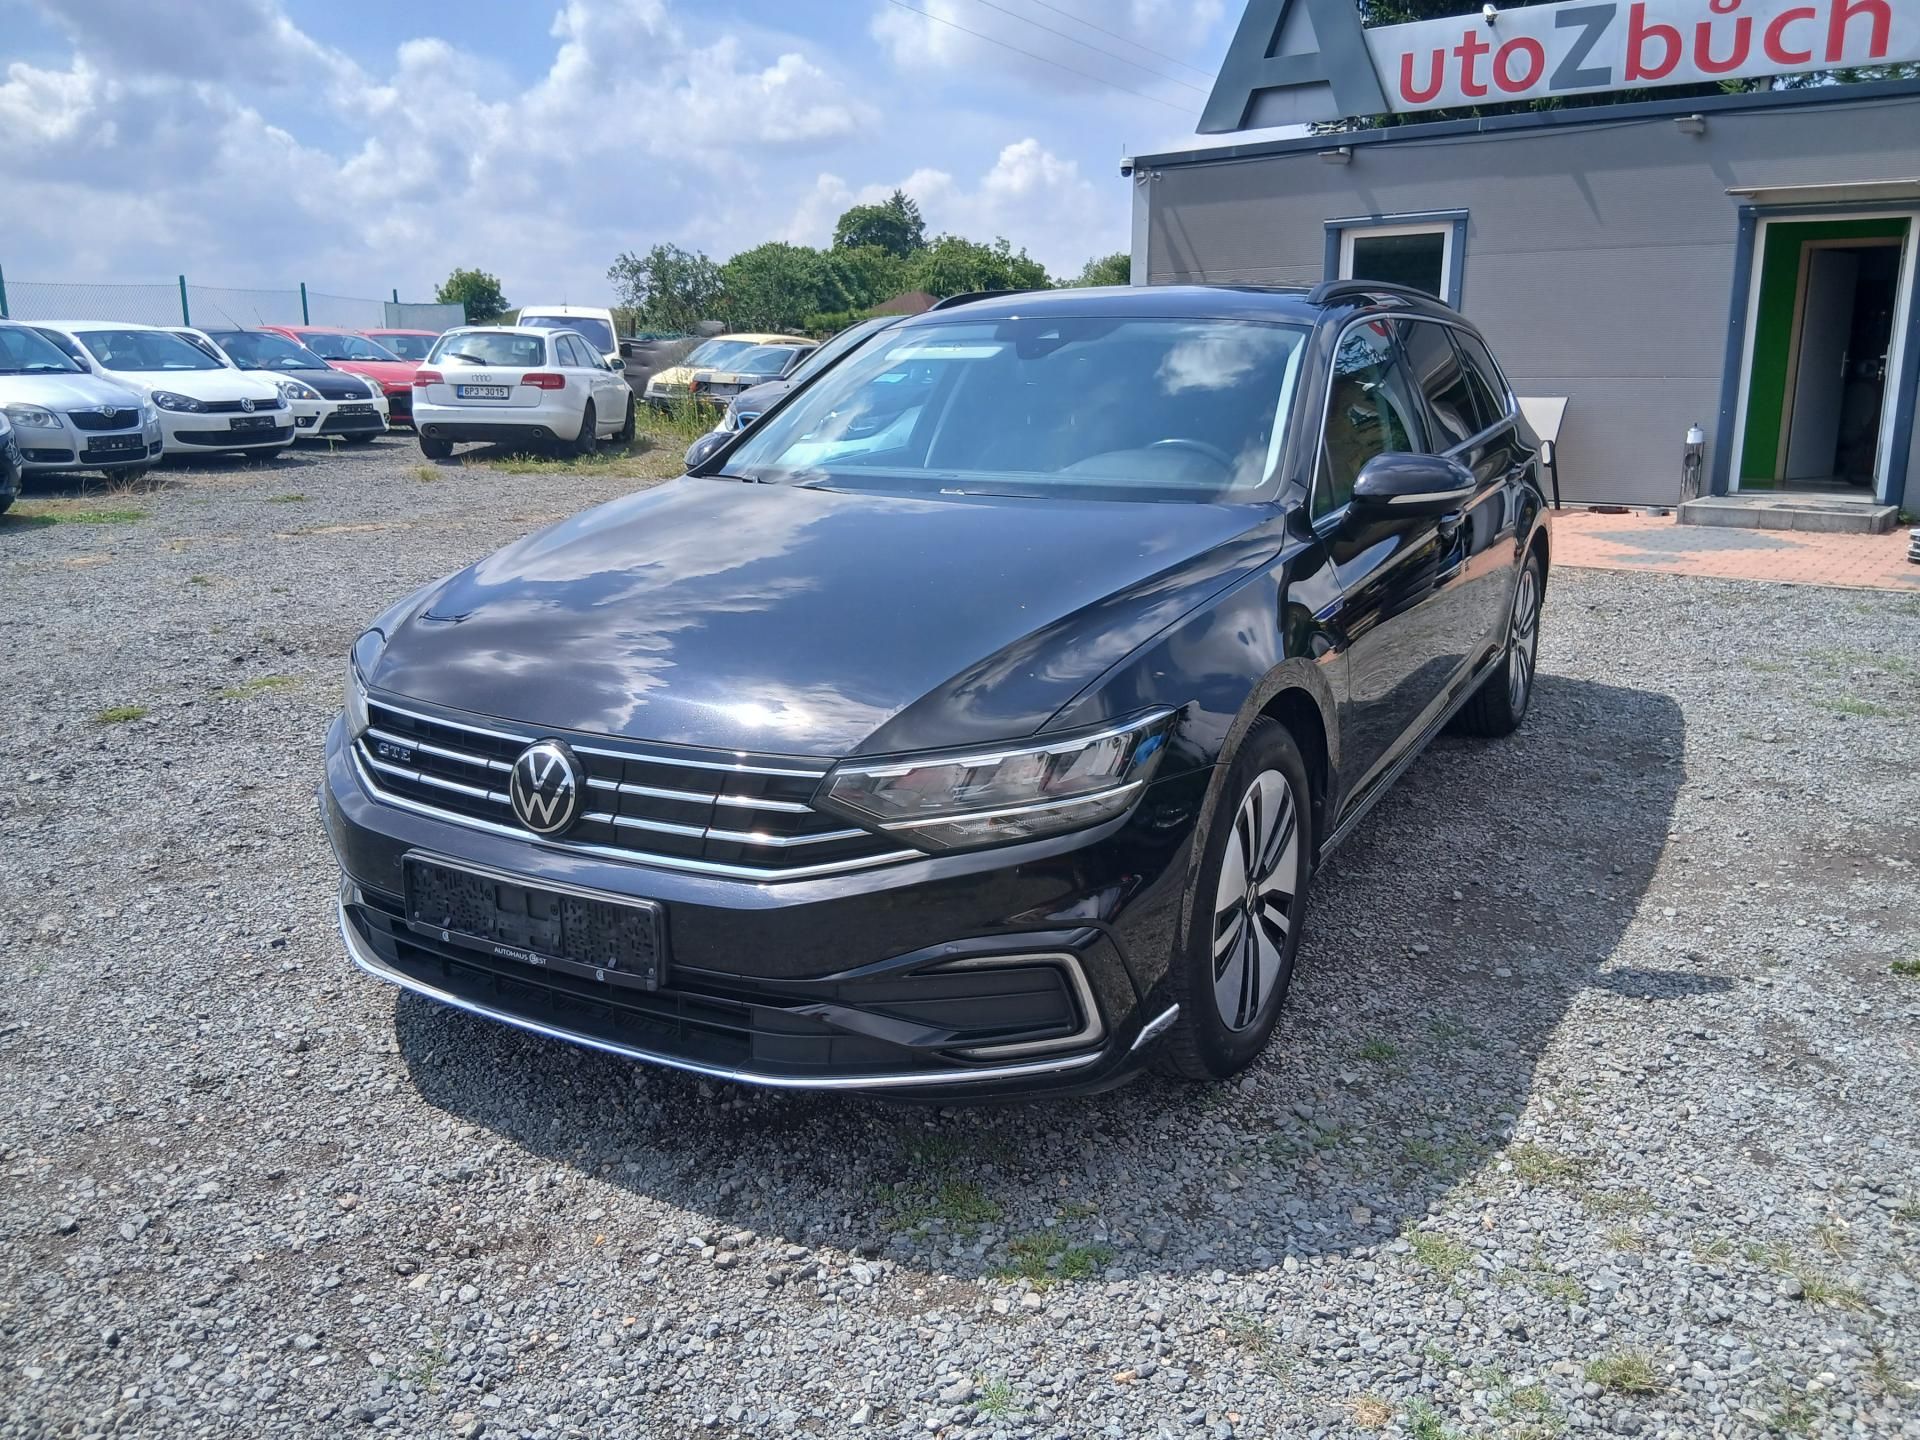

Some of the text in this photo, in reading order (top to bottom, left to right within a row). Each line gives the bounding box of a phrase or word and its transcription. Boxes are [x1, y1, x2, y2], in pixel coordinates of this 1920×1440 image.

[464, 387, 505, 397] 6P3 3015
[494, 946, 528, 961] AUTOHAUS
